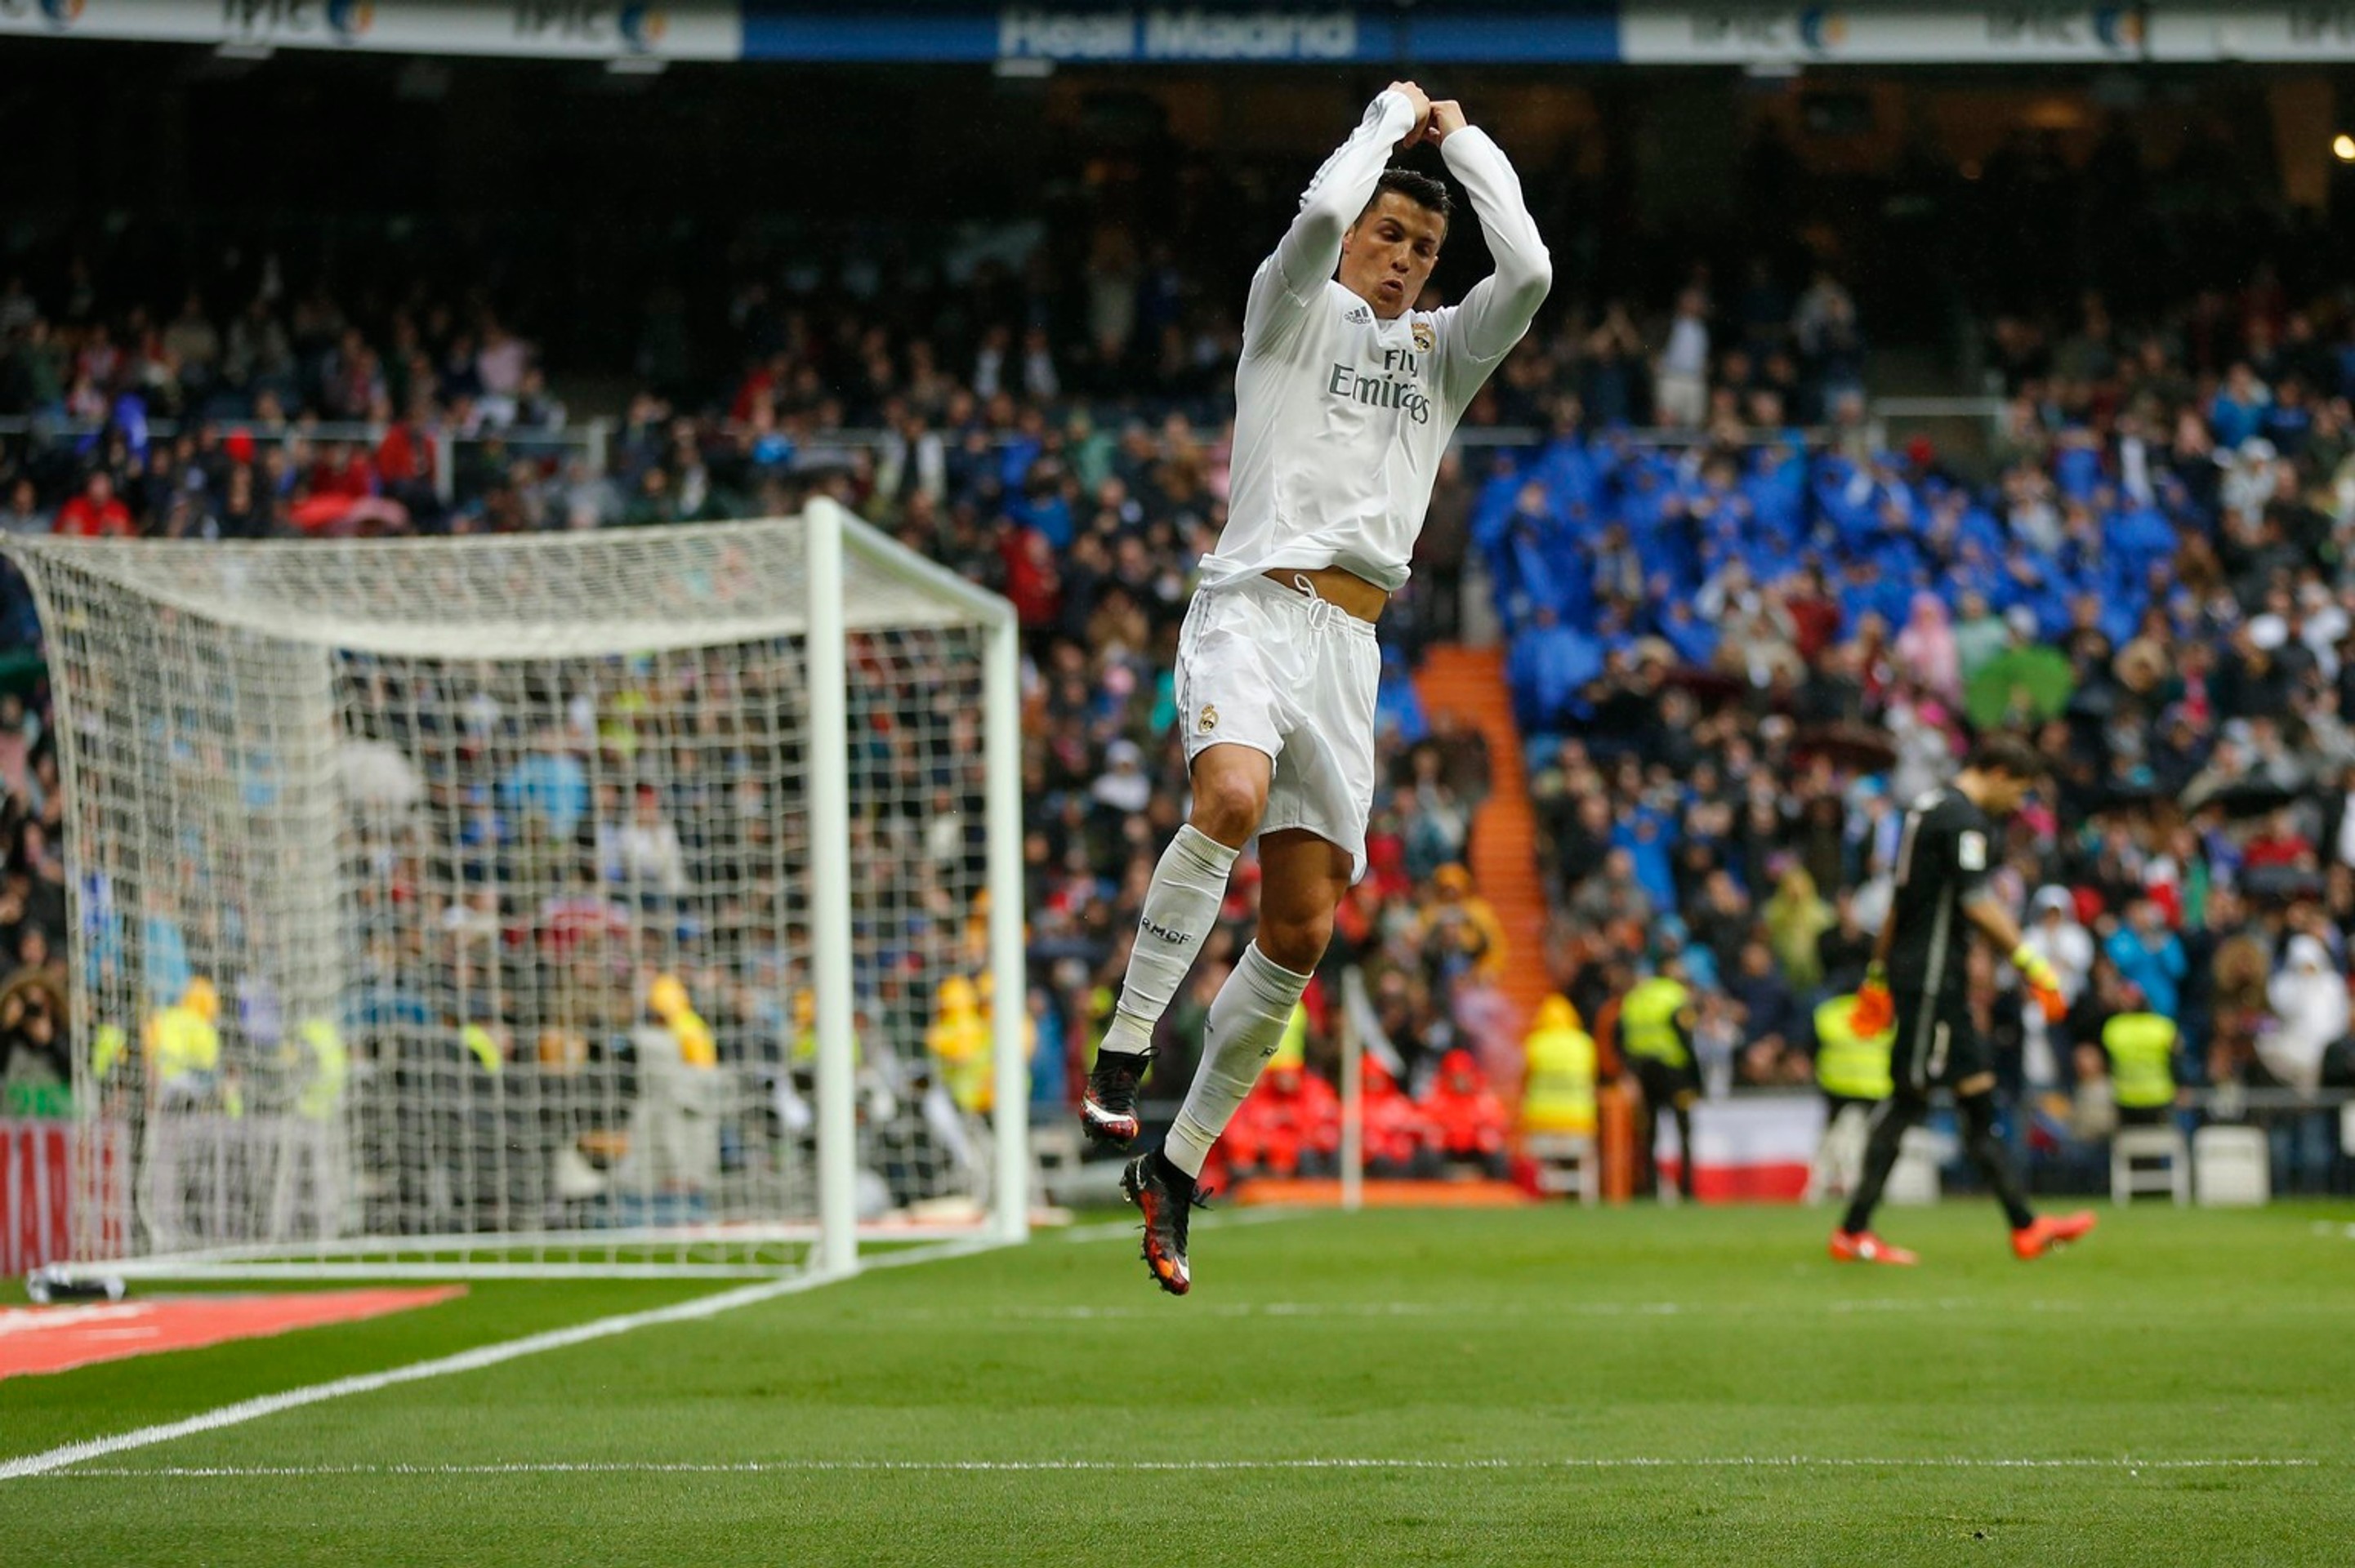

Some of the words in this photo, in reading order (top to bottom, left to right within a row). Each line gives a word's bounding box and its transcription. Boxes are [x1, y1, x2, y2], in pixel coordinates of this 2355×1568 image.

[1146, 9, 1355, 58] Madrid
[1385, 349, 1418, 378] Fly
[1329, 363, 1430, 425] Emiraes
